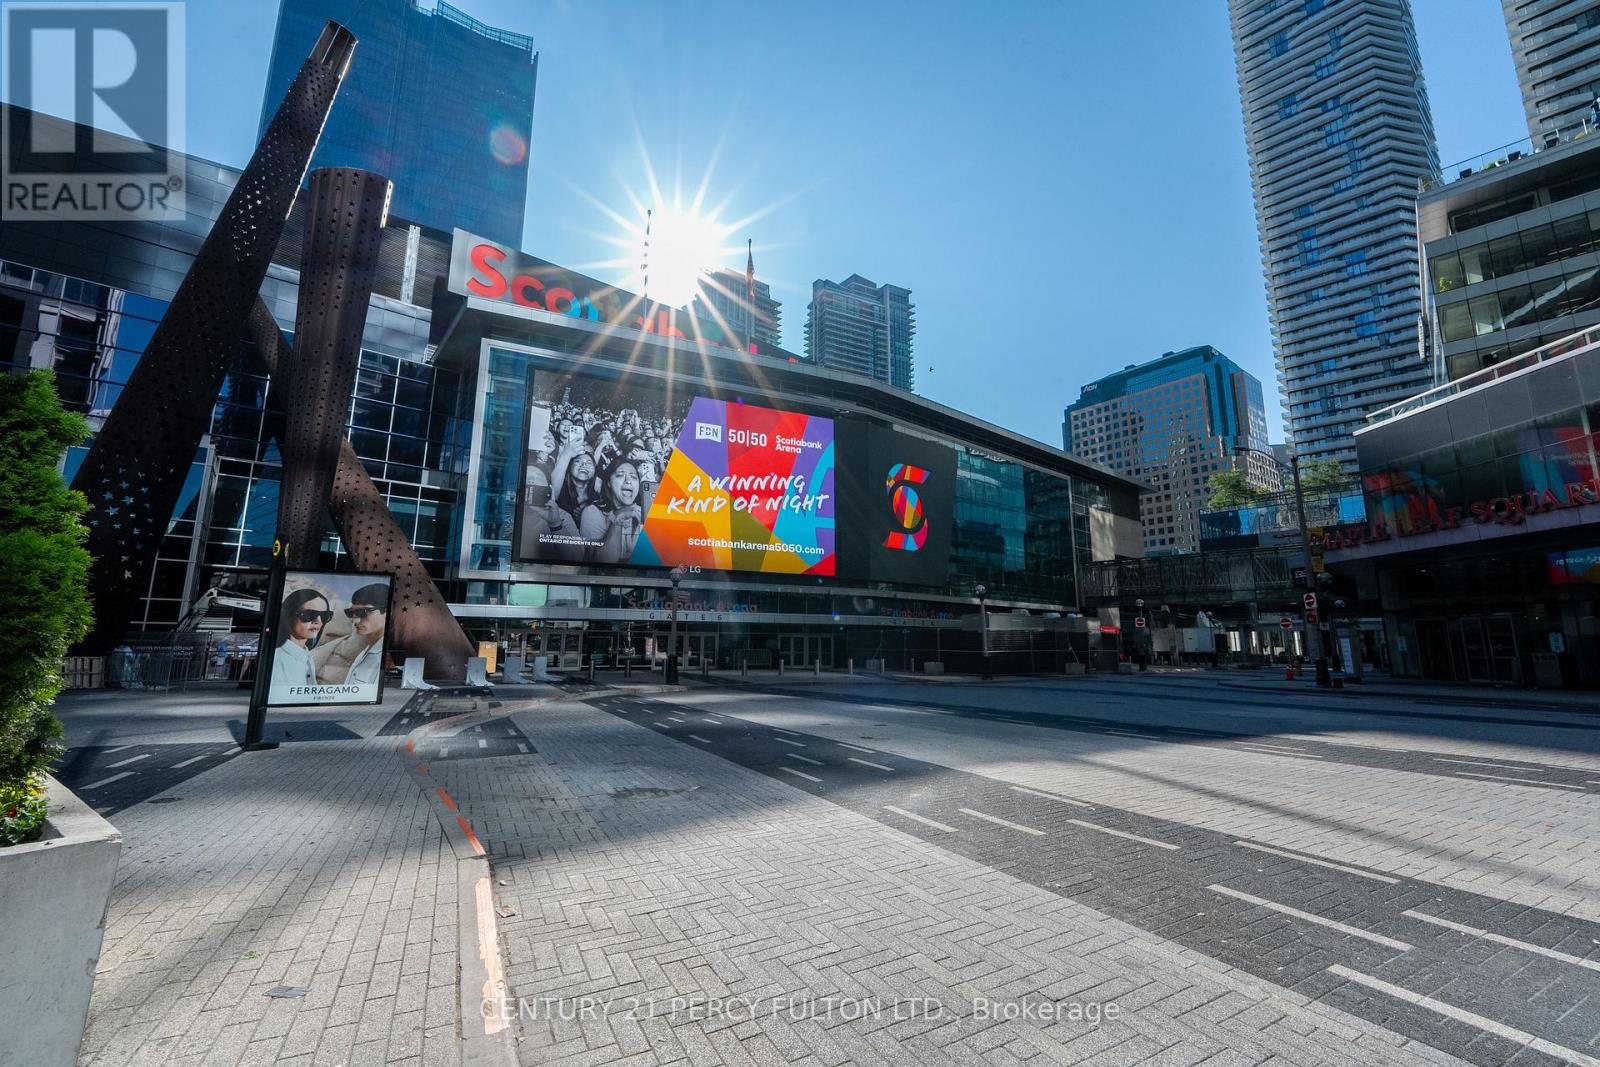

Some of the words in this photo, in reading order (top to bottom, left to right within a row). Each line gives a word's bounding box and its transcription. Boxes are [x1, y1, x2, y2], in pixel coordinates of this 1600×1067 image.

[699, 425, 719, 438] FDN
[775, 435, 823, 449] Scotiabank
[775, 444, 802, 454] Arena
[688, 474, 702, 492] A
[709, 473, 805, 494] WINNING
[666, 495, 728, 515] KIND
[765, 493, 830, 514] NIGHT
[688, 537, 825, 555] scotiabankarena5050.com
[689, 565, 701, 574] LG
[289, 685, 360, 695] FERRAGAMO
